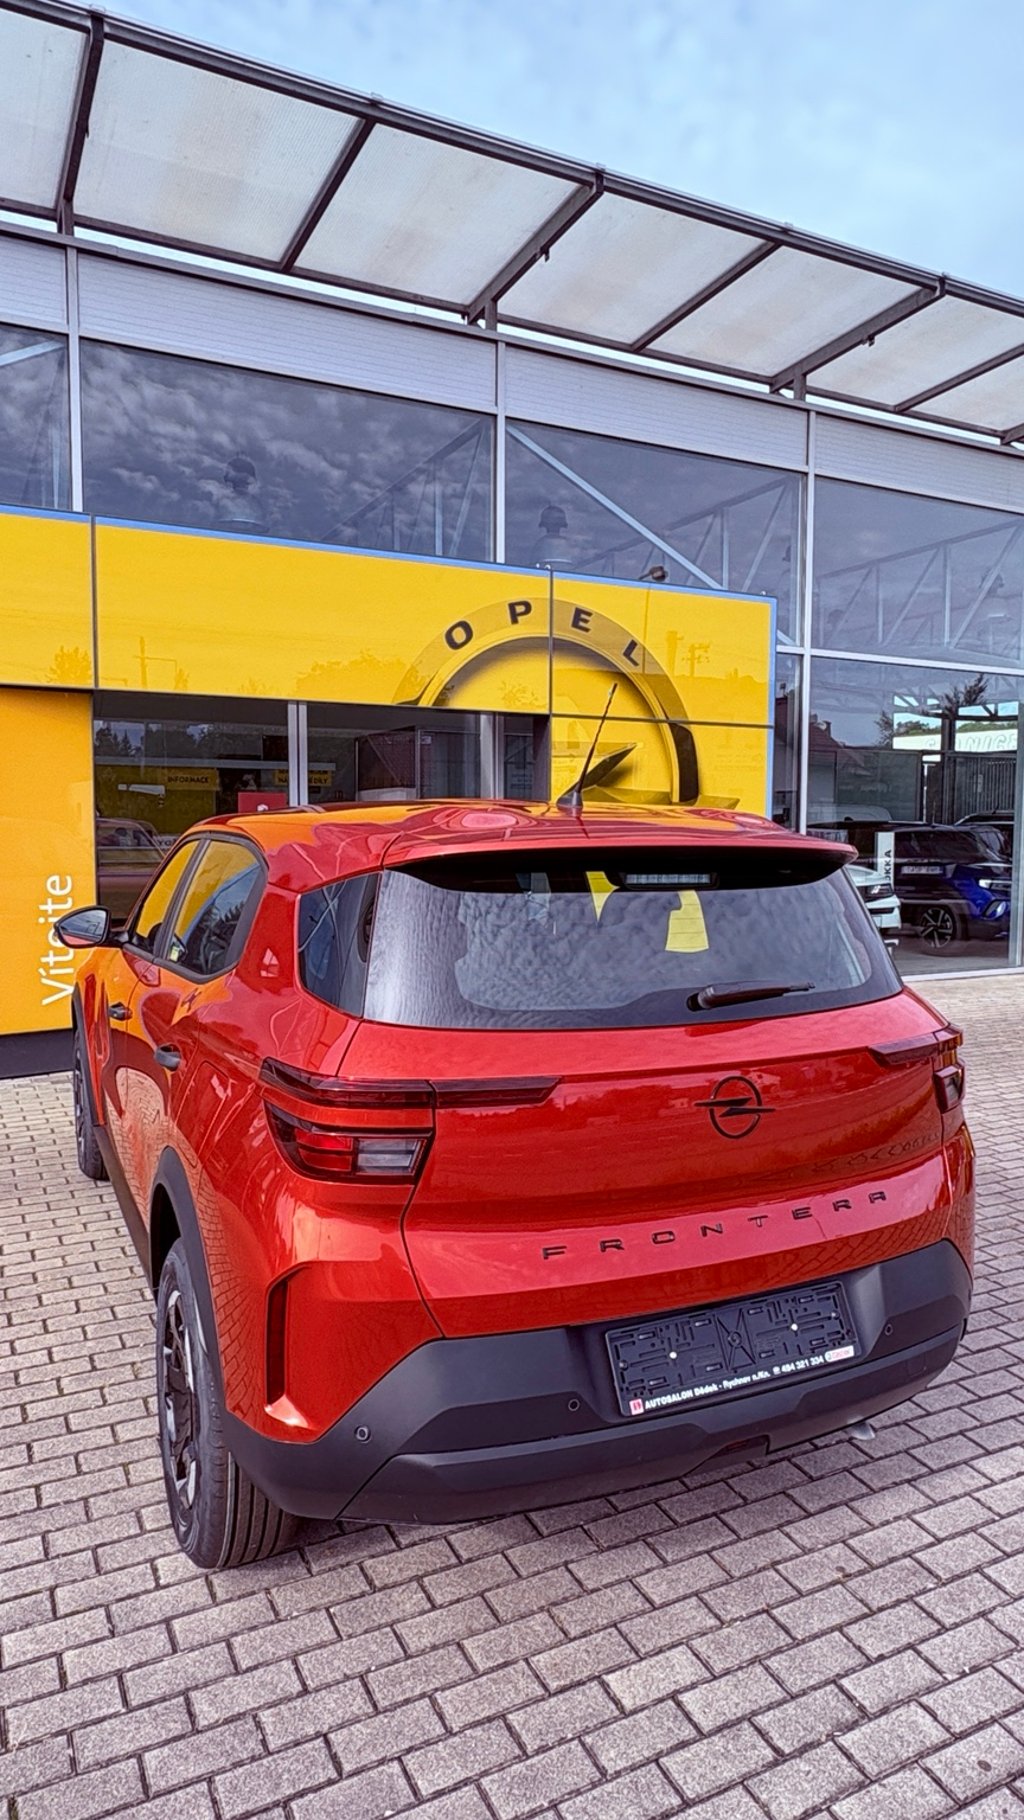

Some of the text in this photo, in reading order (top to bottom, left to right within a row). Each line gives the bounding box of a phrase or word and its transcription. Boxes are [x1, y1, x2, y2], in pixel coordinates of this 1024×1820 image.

[444, 600, 643, 667] OPEL
[167, 775, 209, 784] INFORMACE
[542, 1190, 887, 1260] FRONTERA
[644, 1390, 693, 1409] AUTOSALON
